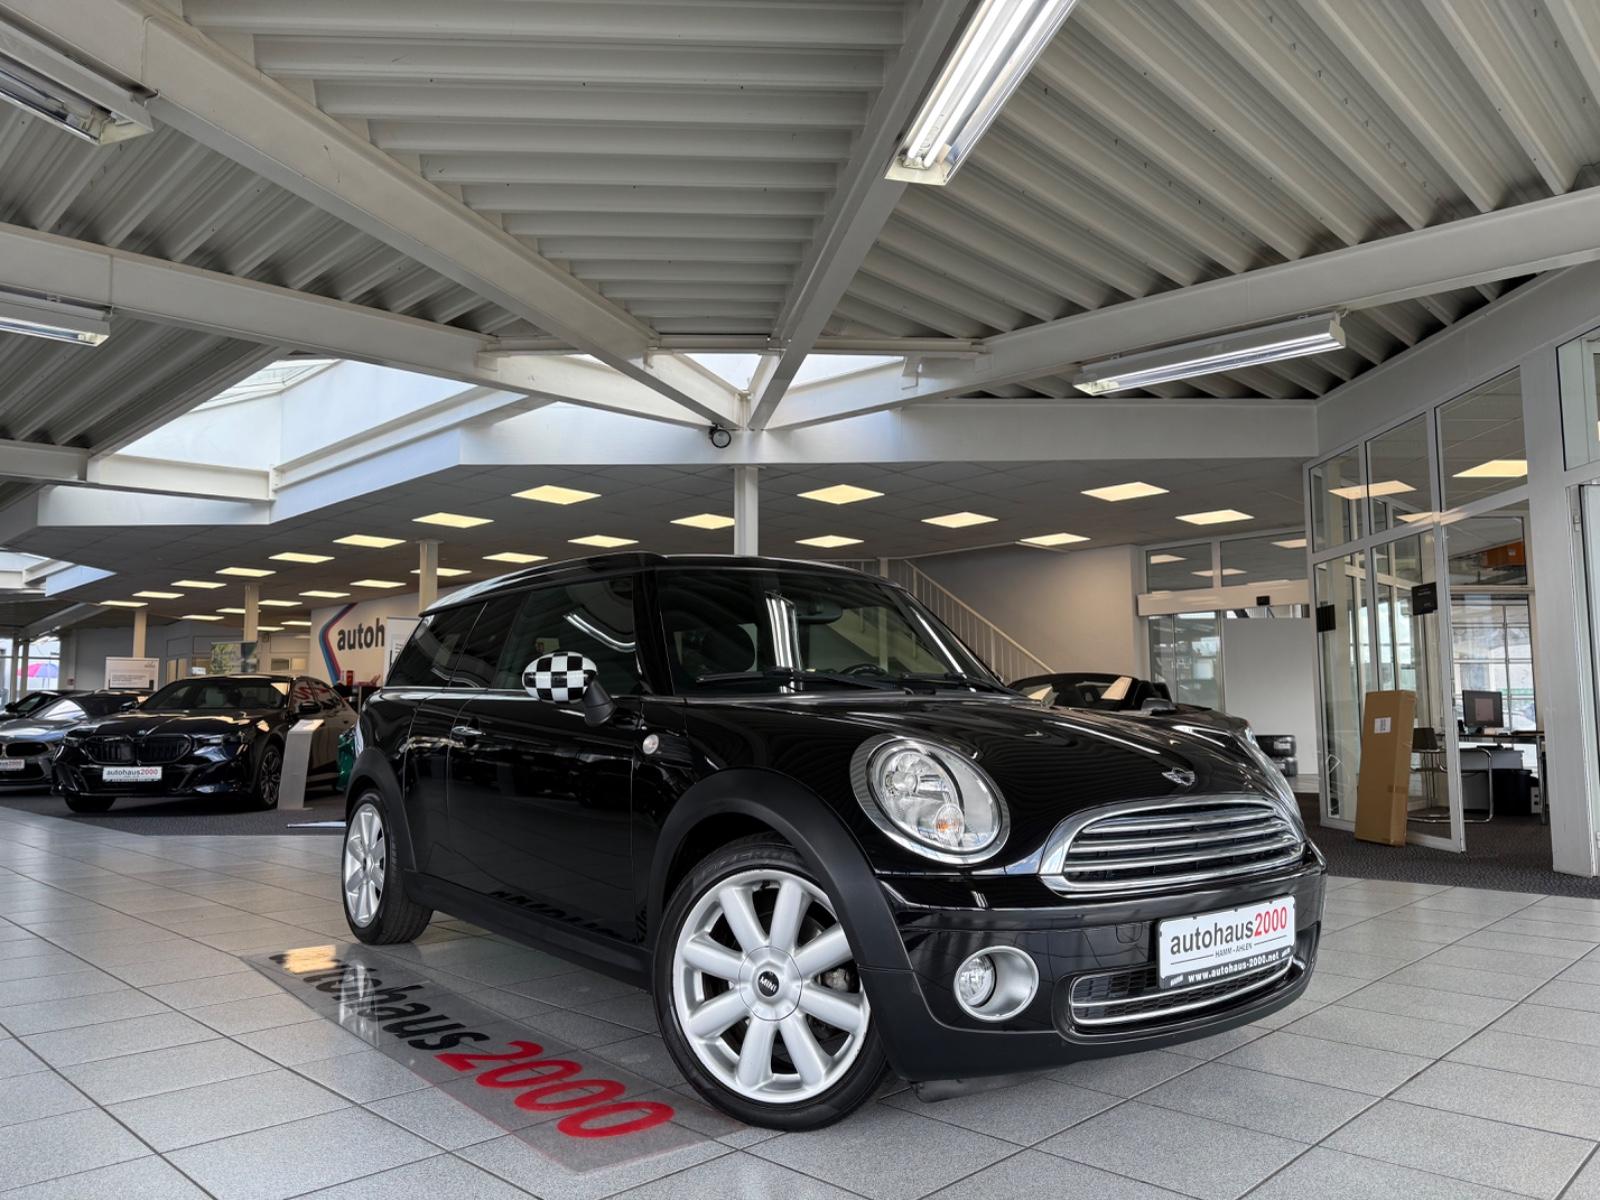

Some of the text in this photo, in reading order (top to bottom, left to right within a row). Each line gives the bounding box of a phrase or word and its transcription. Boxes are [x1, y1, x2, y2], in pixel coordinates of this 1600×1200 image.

[106, 768, 158, 776] autohaus2000
[1170, 906, 1288, 955] autohaus2000
[1188, 951, 1279, 983] www.autohaus-2000.net
